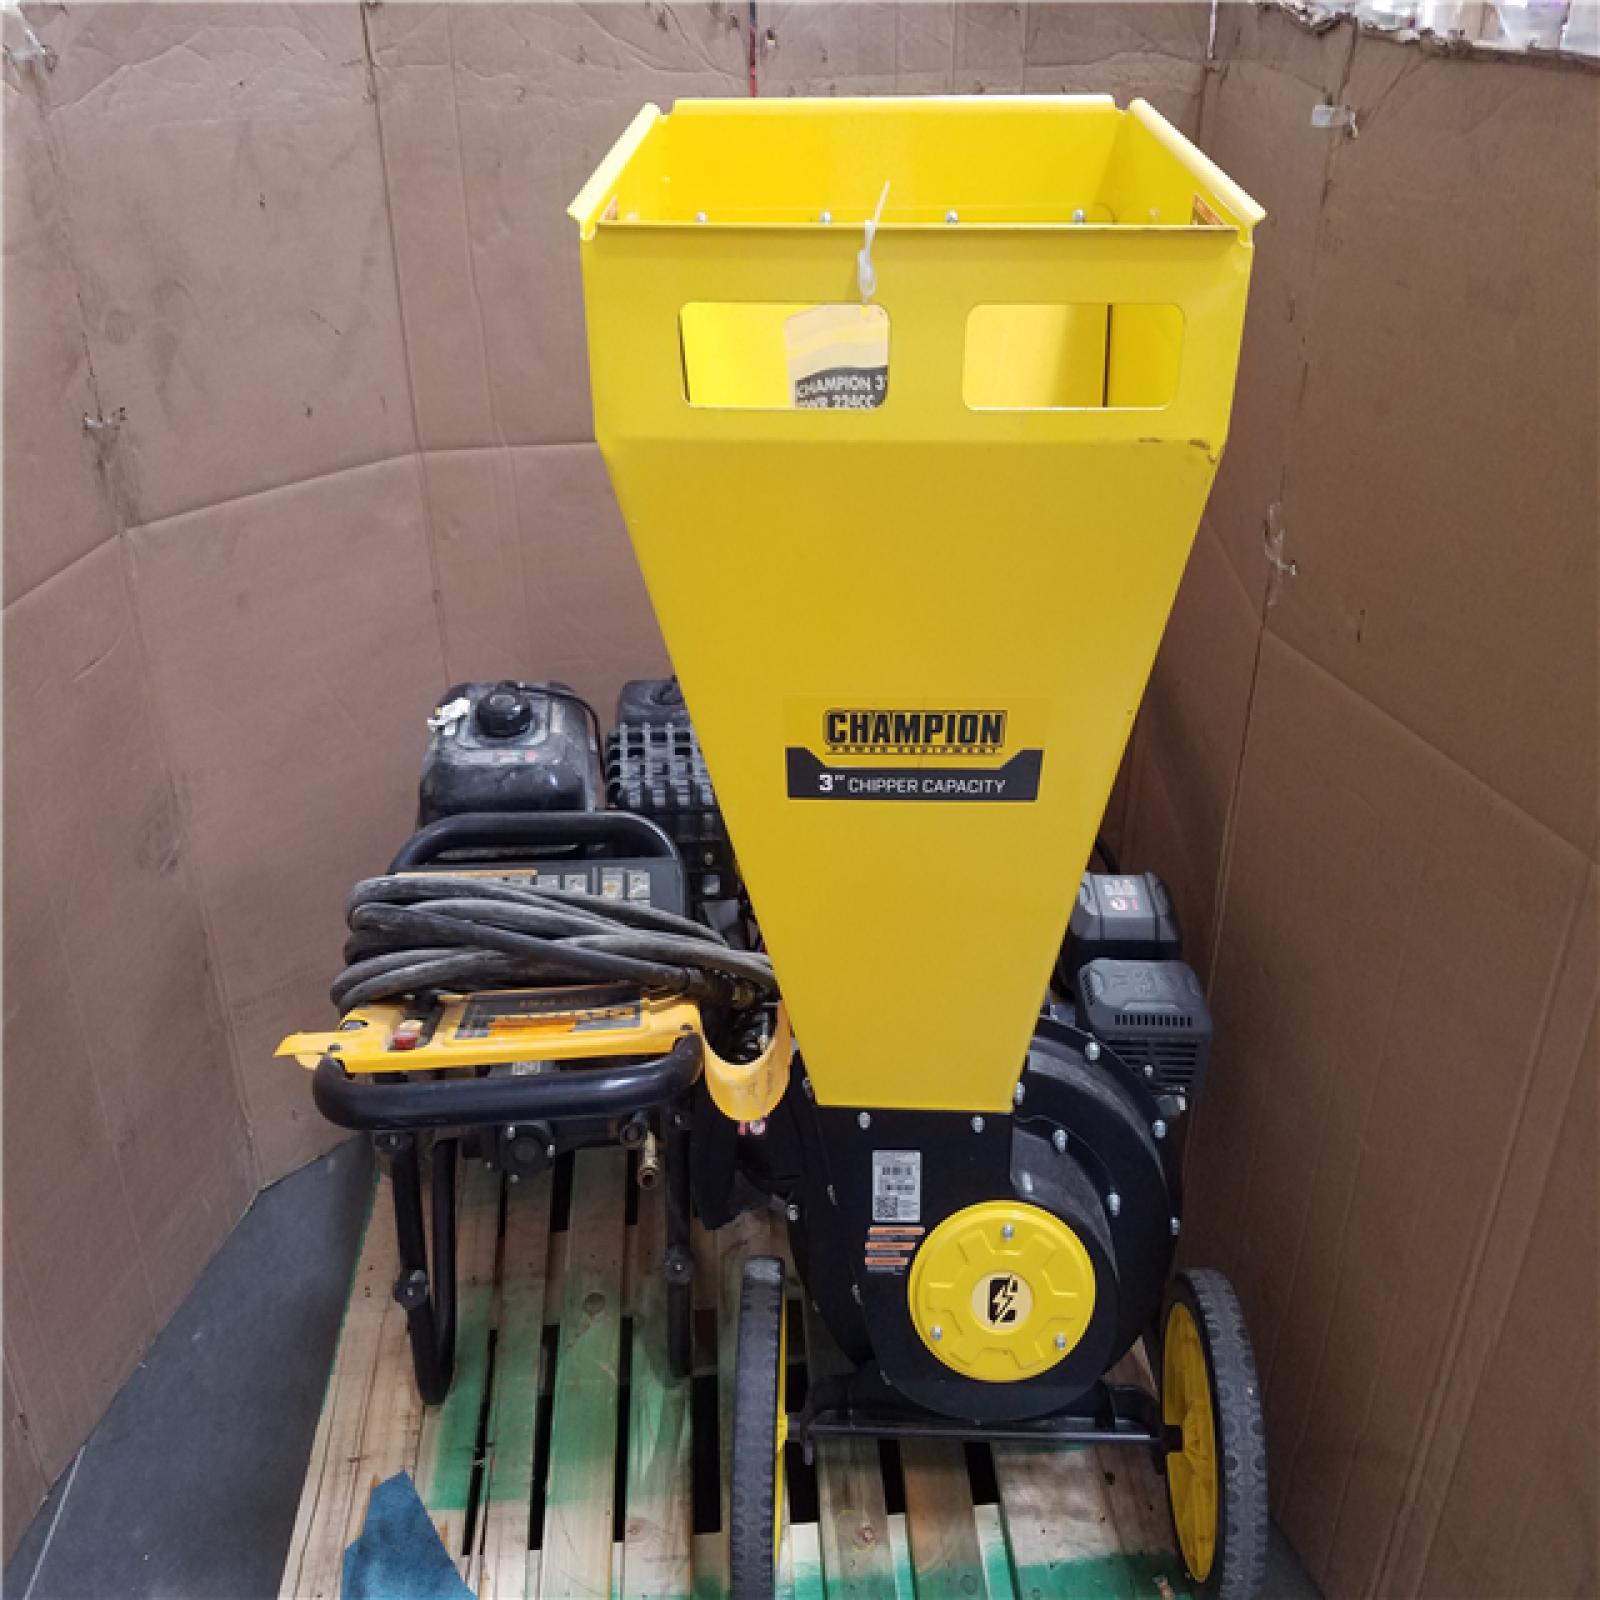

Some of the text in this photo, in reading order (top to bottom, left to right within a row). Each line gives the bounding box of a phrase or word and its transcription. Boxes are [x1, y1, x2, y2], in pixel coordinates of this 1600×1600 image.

[798, 375, 871, 397] CHAMPION
[825, 711, 1005, 744] CHAMPION
[848, 778, 918, 793] CHIPPER
[921, 778, 1006, 793] CAPACITY
